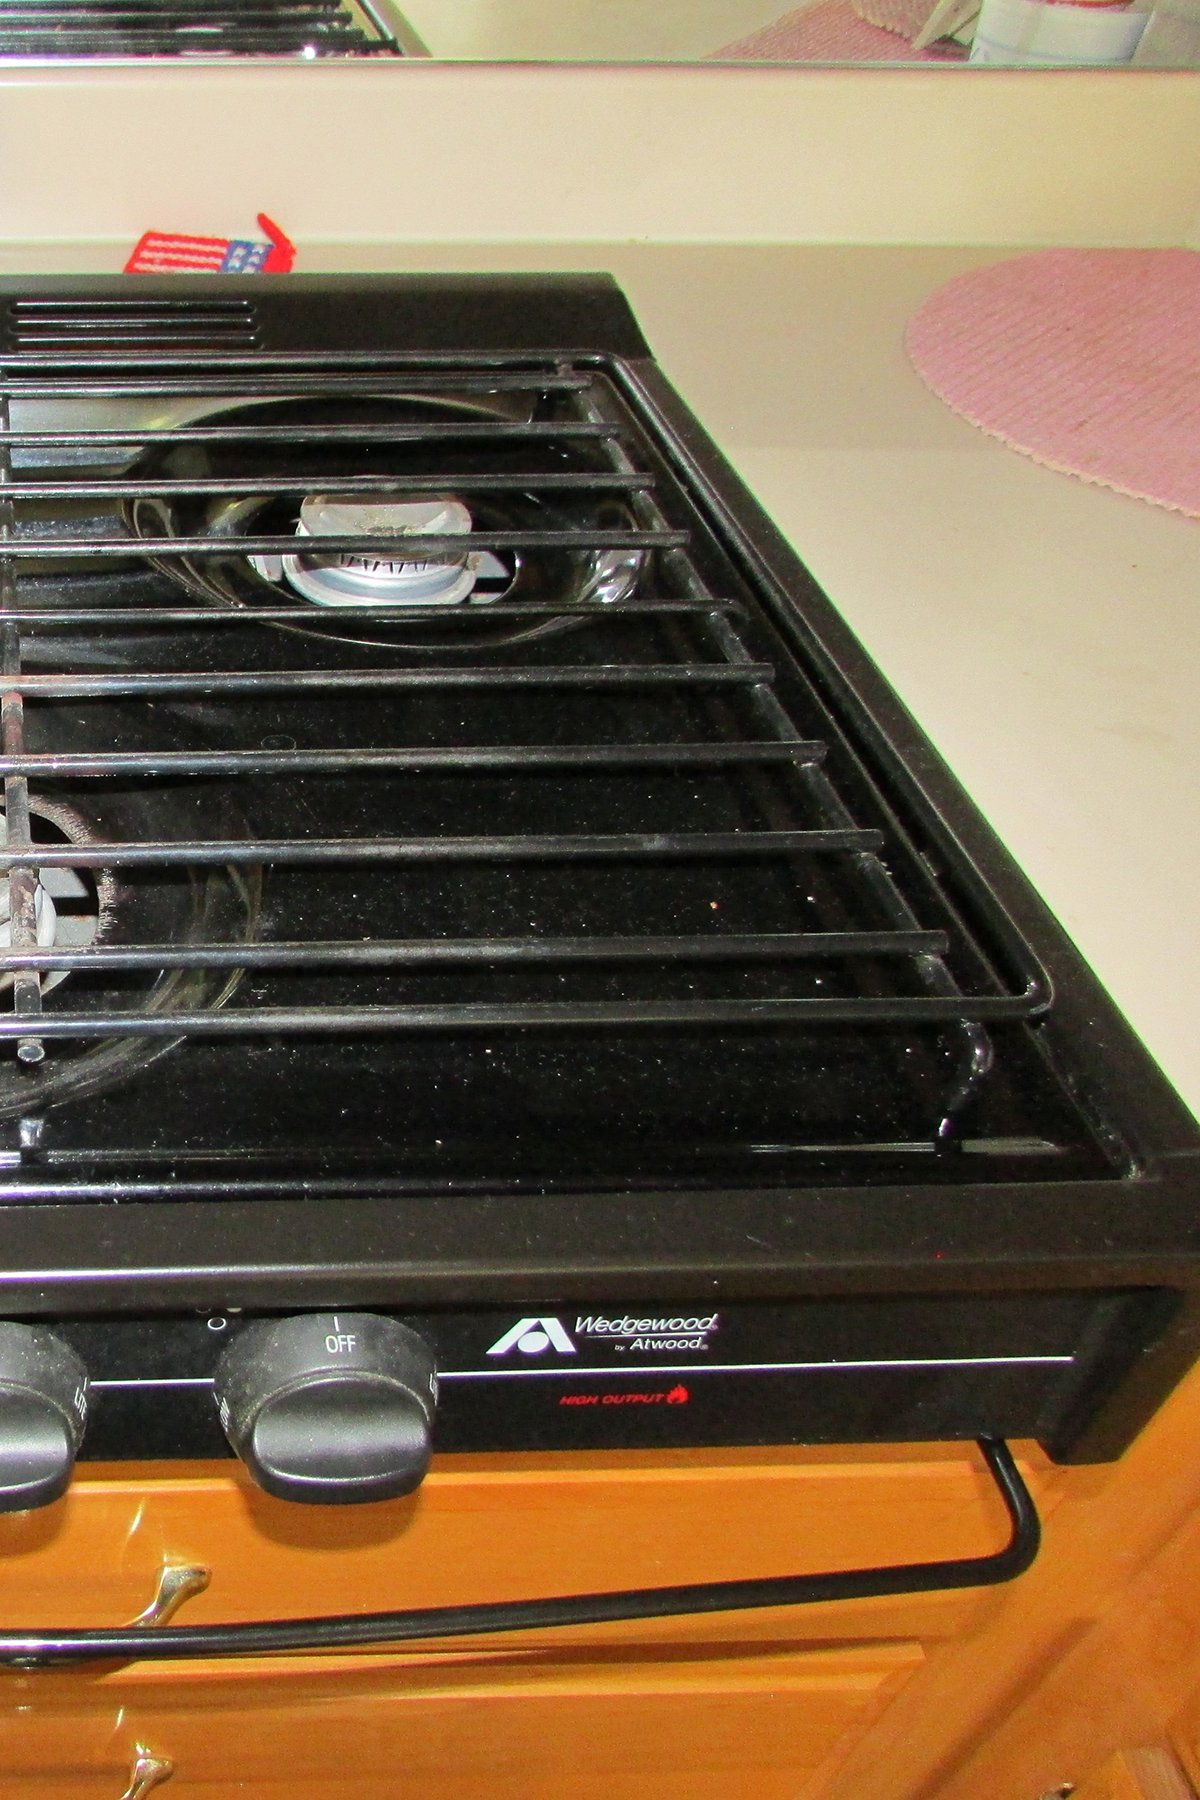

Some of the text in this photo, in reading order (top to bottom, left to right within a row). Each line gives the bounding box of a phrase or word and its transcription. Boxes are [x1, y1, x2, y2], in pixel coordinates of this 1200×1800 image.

[574, 1312, 719, 1335] Wedgewood
[325, 1334, 356, 1354] OFF
[614, 1336, 702, 1352] by Atwood
[559, 1392, 666, 1406] HIGH OUTPUT
